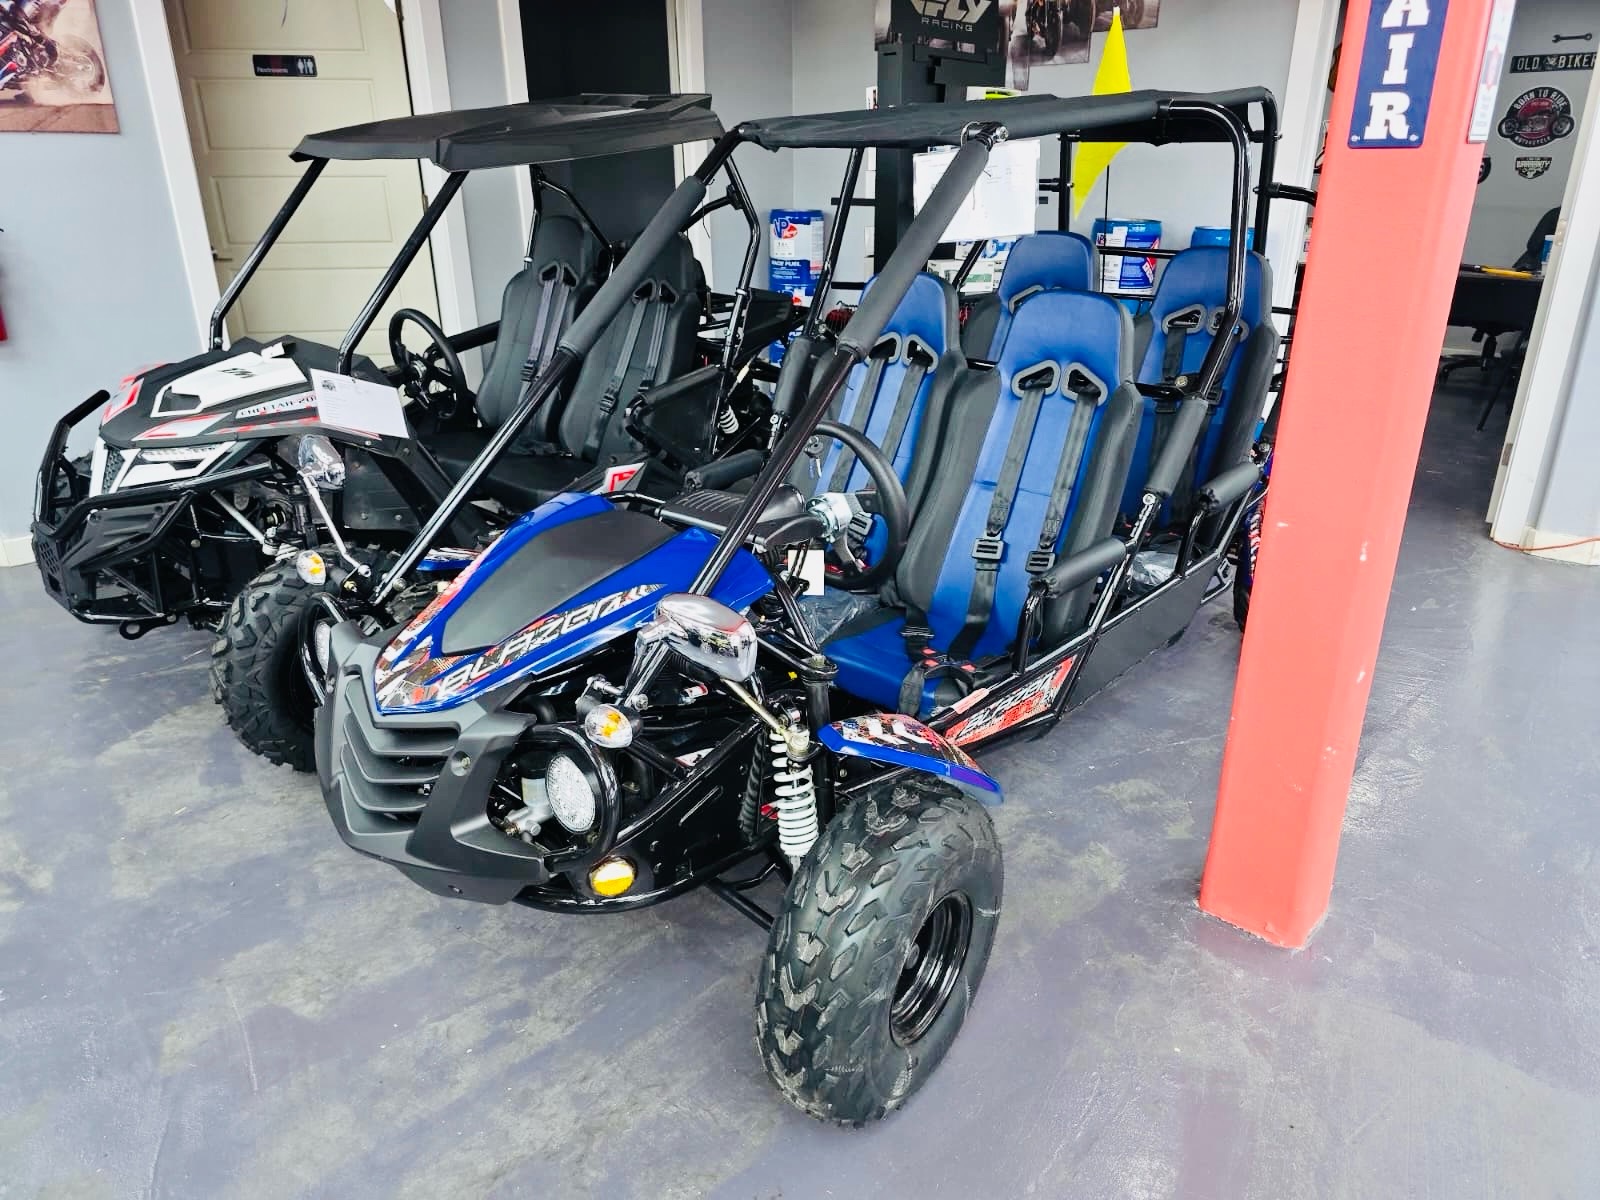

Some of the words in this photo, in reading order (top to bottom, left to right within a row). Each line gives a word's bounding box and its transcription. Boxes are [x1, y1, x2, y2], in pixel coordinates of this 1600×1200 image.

[921, 16, 973, 32] RACING
[1517, 56, 1541, 71] OLD
[1513, 90, 1535, 110] BORN
[1538, 88, 1550, 97] TO
[1550, 91, 1568, 109] RIDE
